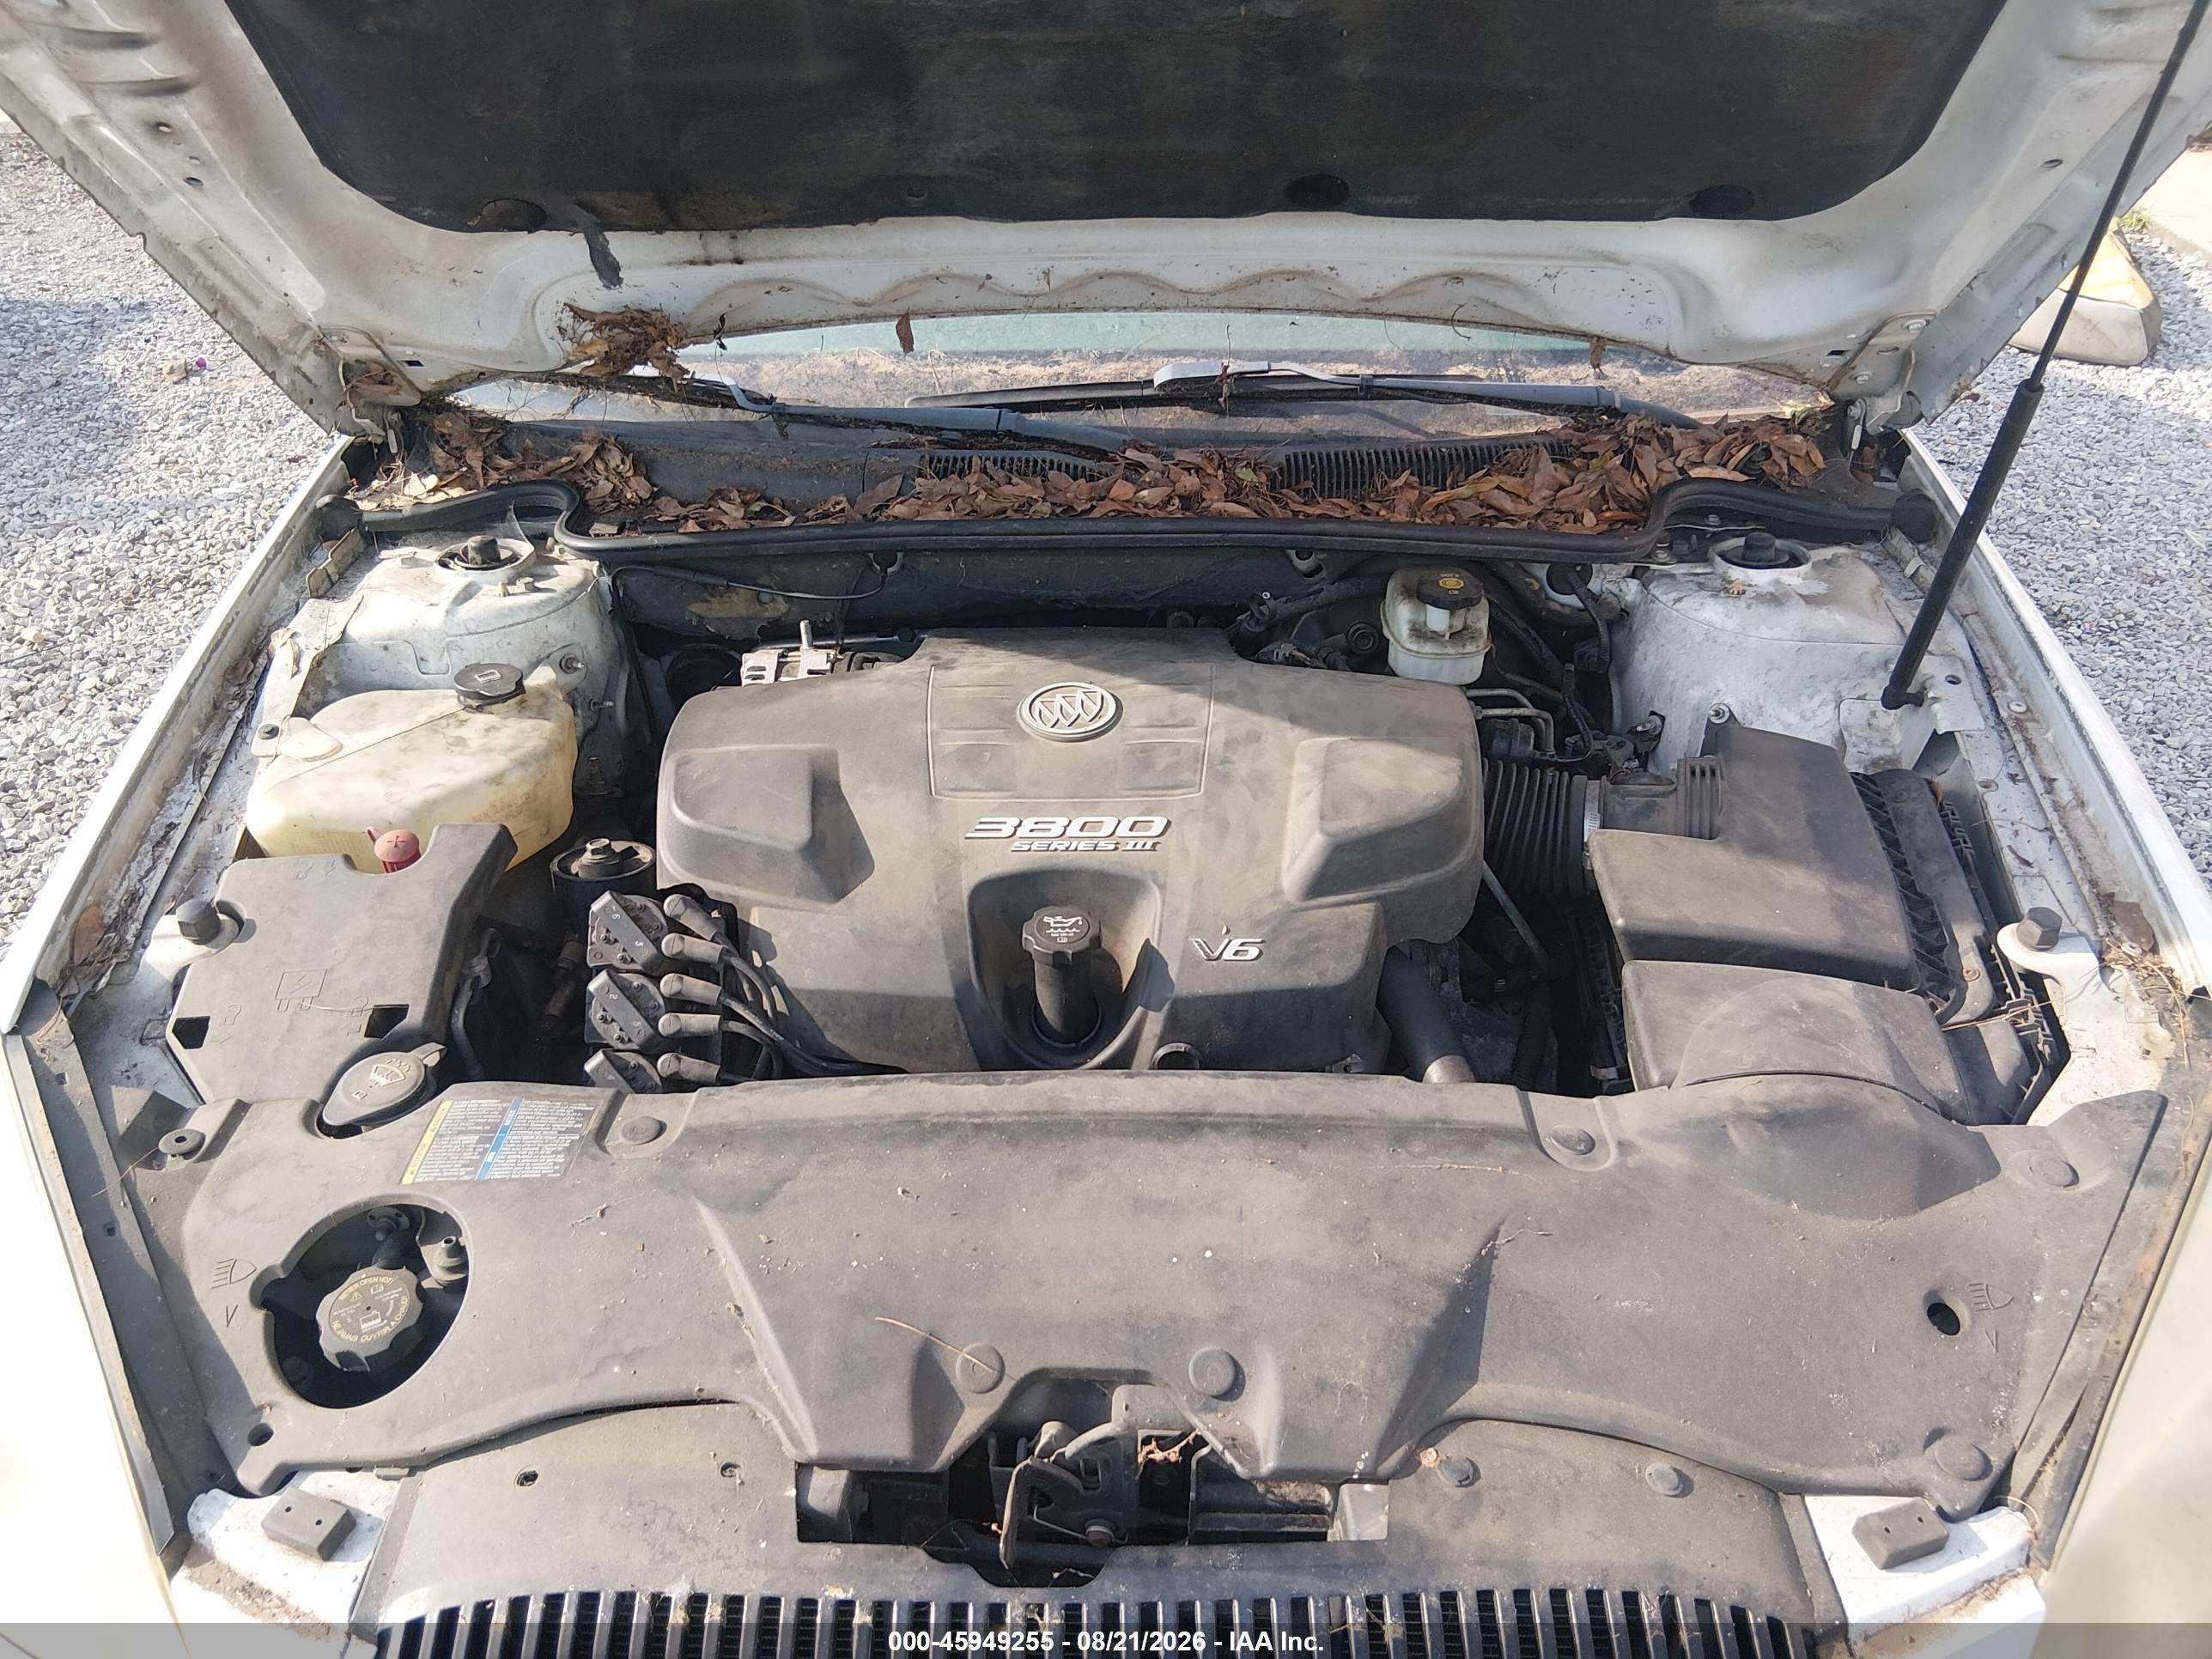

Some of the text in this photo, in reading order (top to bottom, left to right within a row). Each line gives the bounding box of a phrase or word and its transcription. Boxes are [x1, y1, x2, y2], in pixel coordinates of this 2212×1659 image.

[965, 816, 1171, 839] 3800
[1011, 840, 1118, 852] SERIES
[1193, 937, 1265, 960] V6
